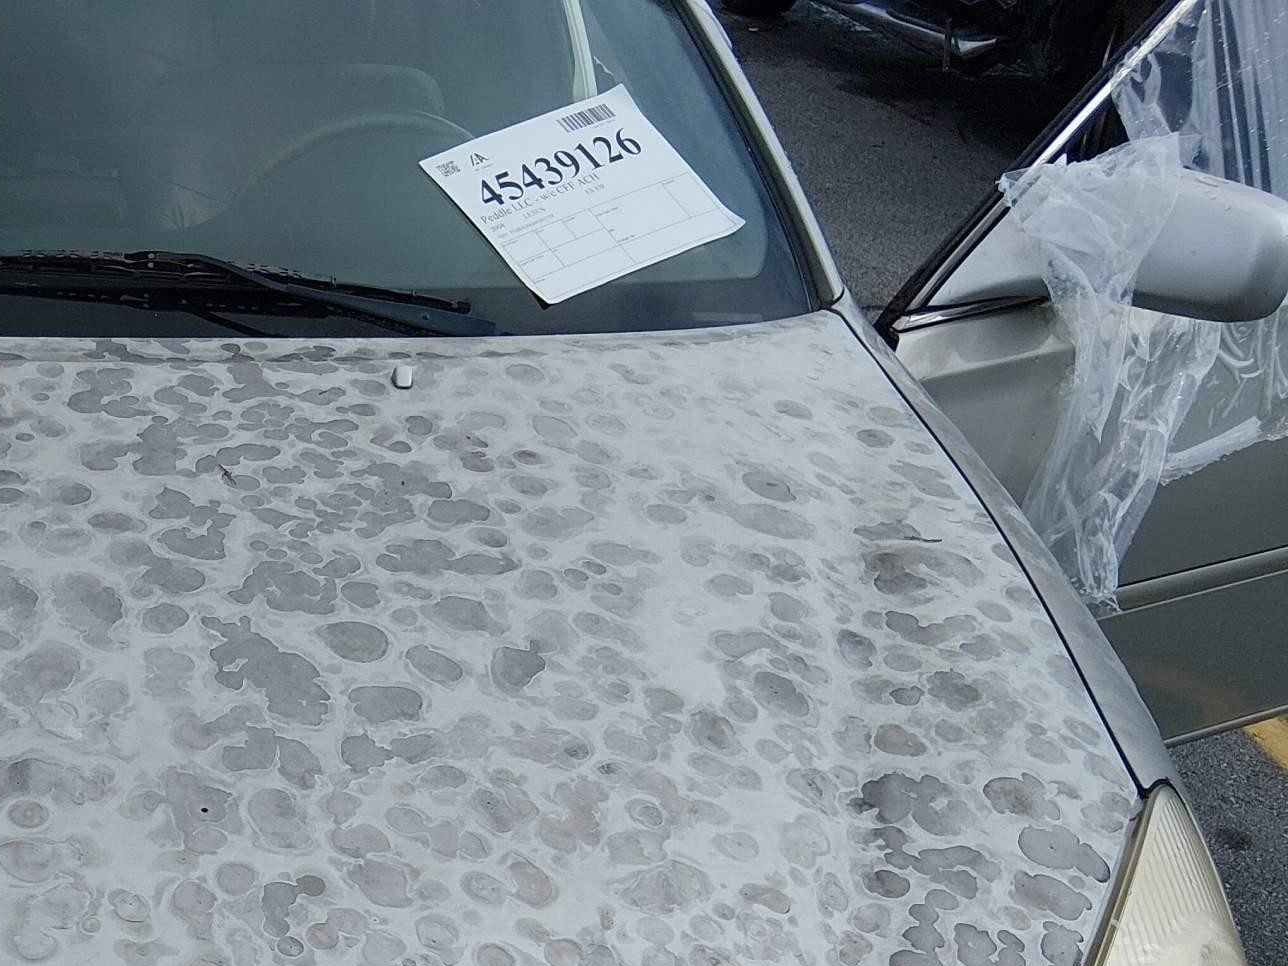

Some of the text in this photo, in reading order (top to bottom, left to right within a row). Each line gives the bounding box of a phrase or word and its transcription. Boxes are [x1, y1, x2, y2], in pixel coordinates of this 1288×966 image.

[480, 206, 513, 224] Peddle
[512, 198, 533, 212] LLC
[577, 173, 601, 187] ACH
[481, 128, 642, 206] 45439126
